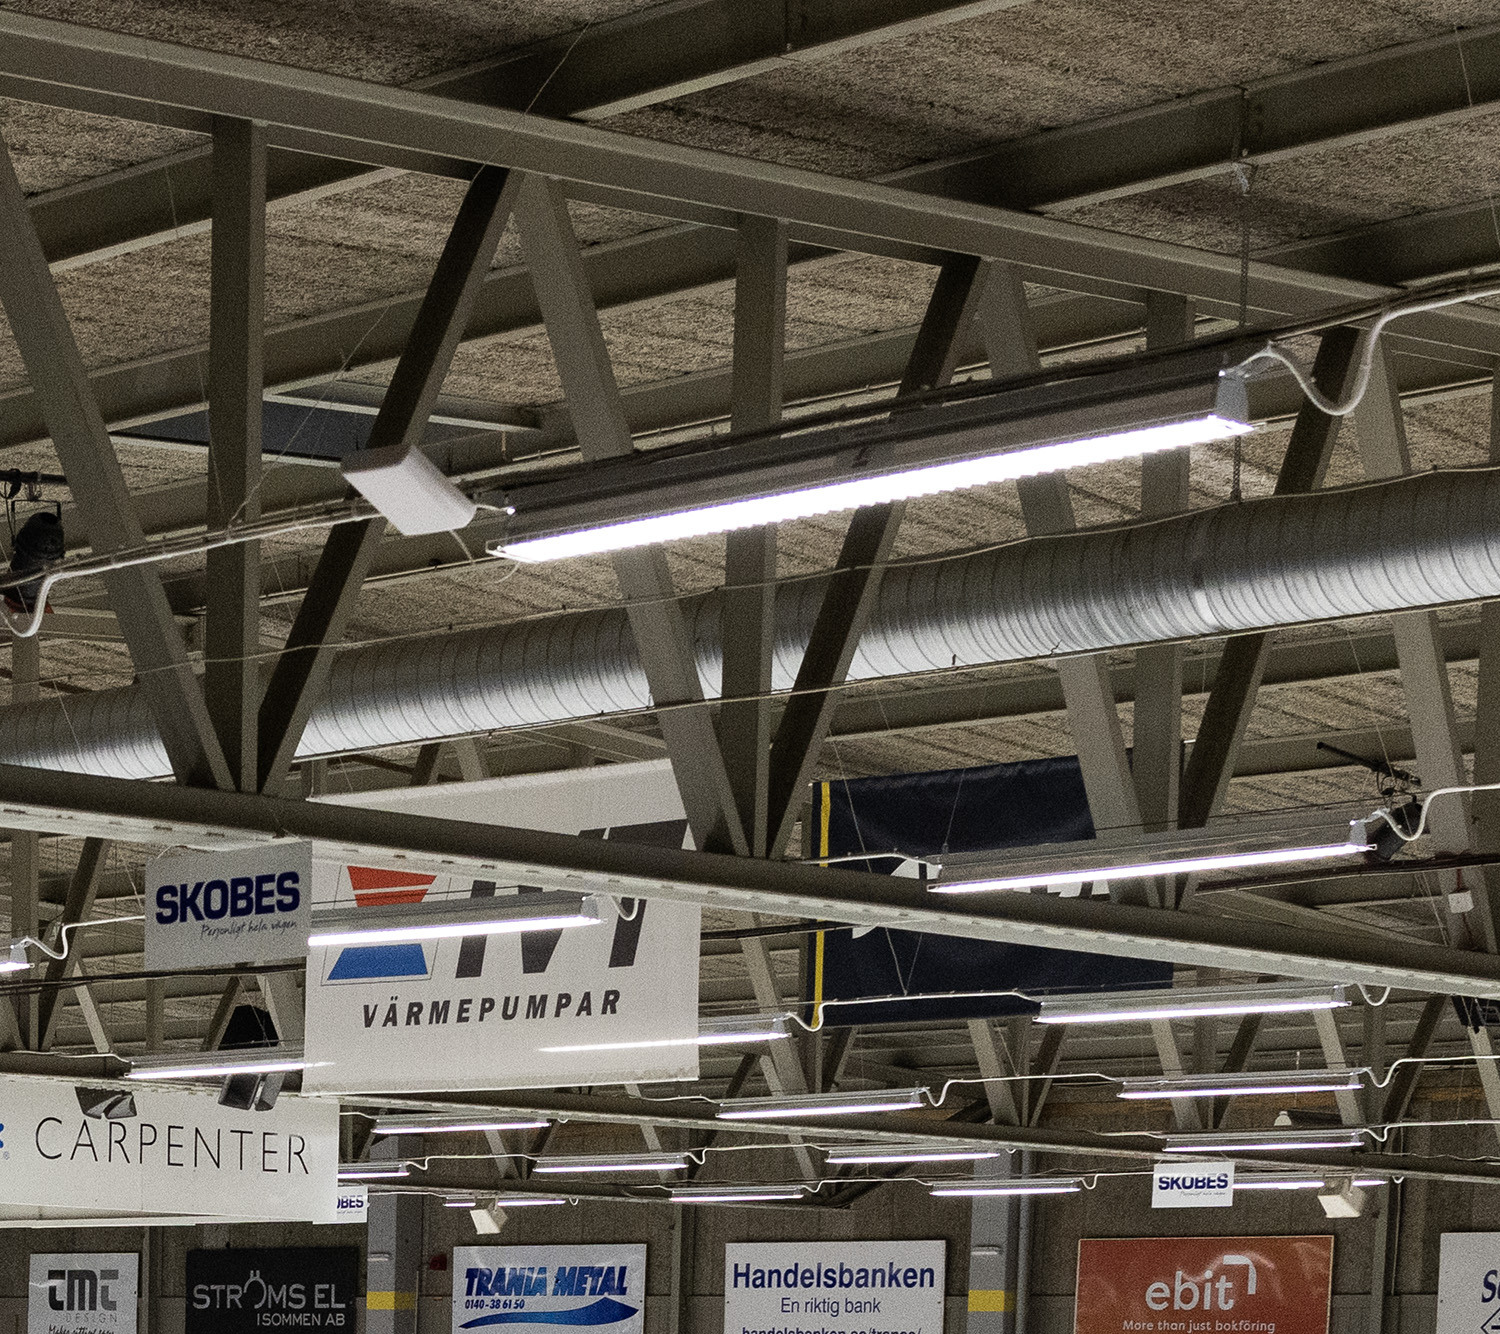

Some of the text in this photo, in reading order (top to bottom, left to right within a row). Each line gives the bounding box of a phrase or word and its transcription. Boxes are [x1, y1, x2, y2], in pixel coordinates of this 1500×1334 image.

[155, 871, 300, 924] SKOBES
[363, 988, 622, 1028] VÄRMEPUMPAR
[36, 1113, 311, 1175] CARPENTER
[1158, 1173, 1228, 1190] SKOBES
[193, 1270, 346, 1309] STRÖMS EL
[552, 1265, 628, 1297] METAL
[733, 1262, 935, 1288] Handelsbanken
[1145, 1270, 1235, 1311] ebit
[781, 1297, 881, 1317] En riktig bank
[1122, 1319, 1276, 1334] More than just bokföring
